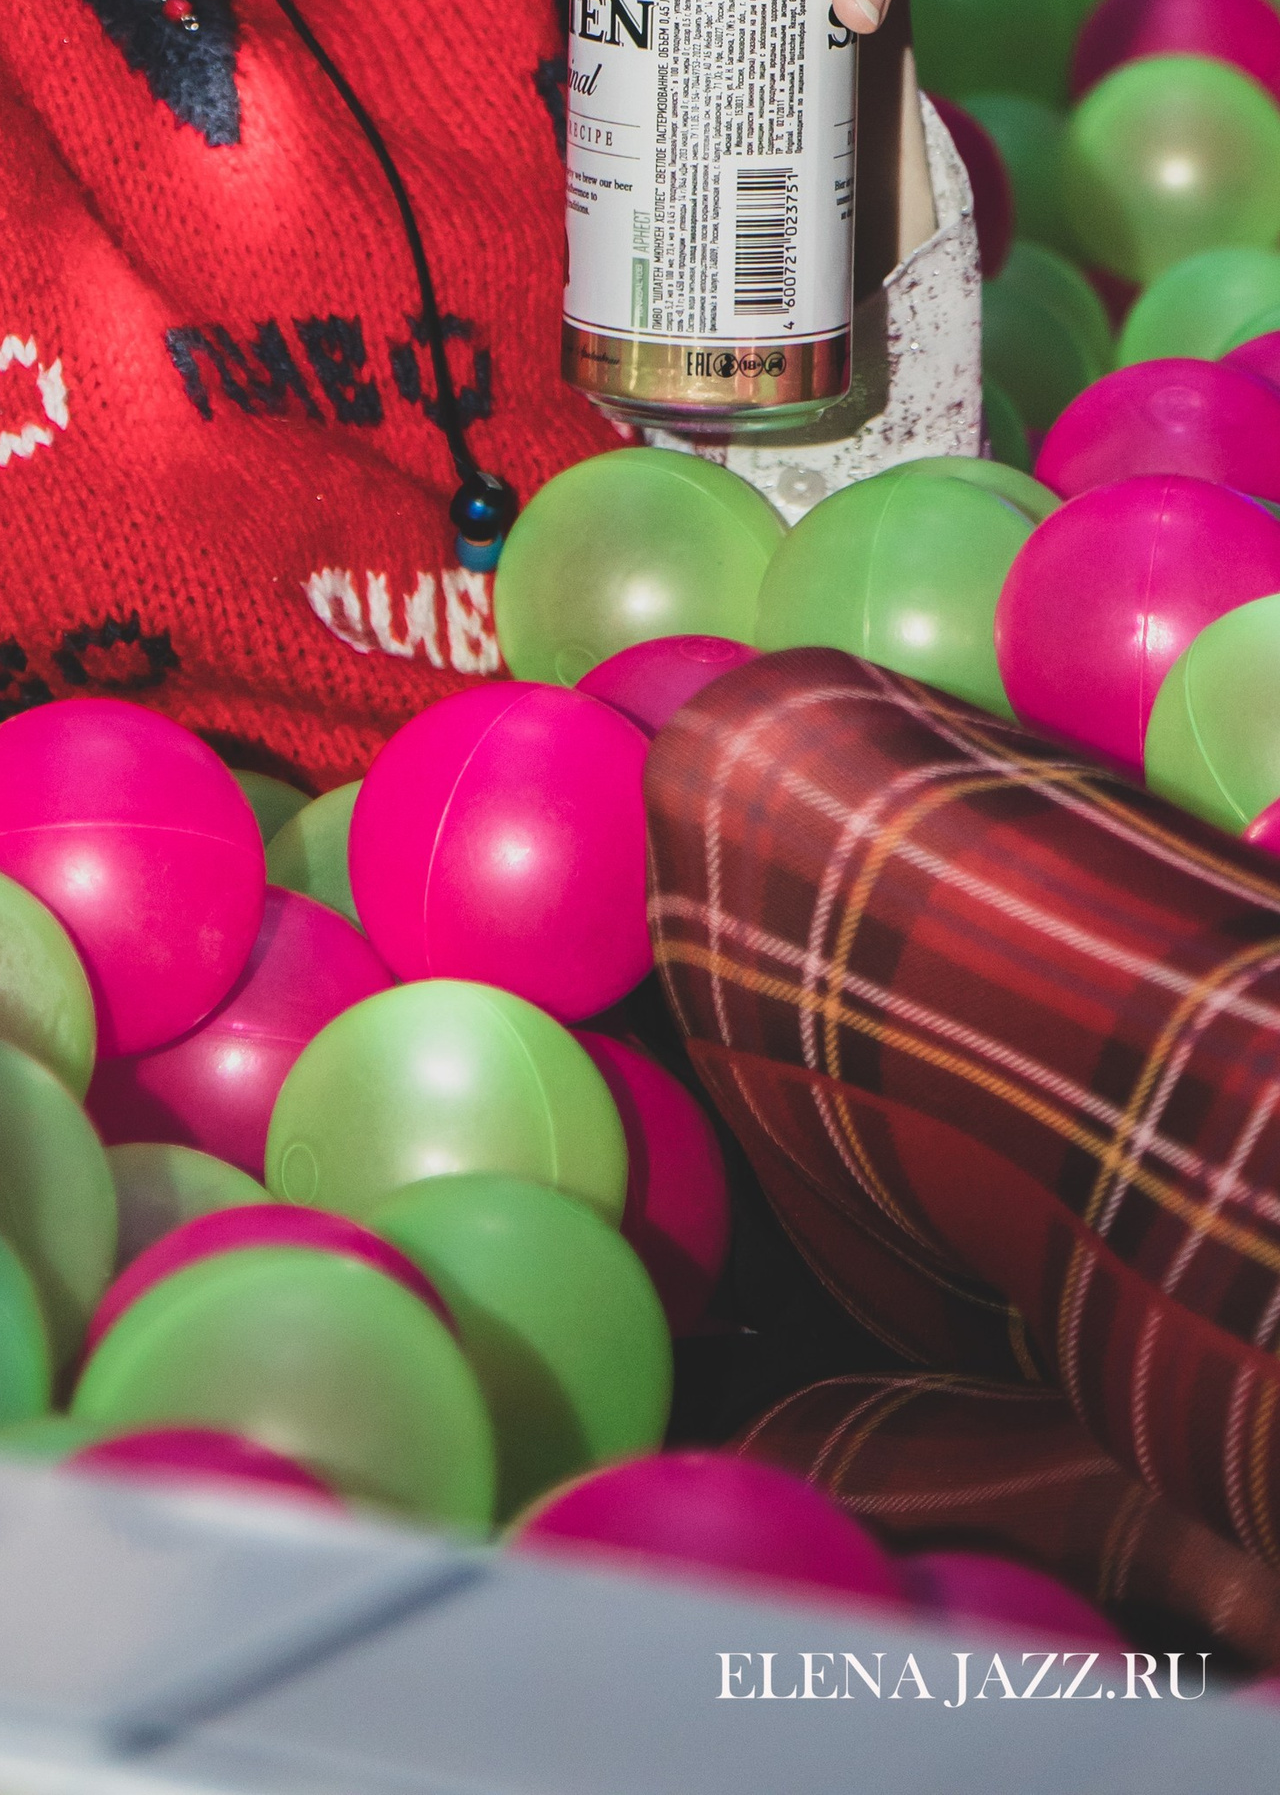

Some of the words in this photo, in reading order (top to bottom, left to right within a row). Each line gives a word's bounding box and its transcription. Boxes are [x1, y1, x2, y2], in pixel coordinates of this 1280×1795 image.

[658, 28, 669, 58] ОБЪЕМ
[655, 148, 667, 184] СВЕТЛОЕ
[599, 179, 612, 188] our
[614, 179, 633, 191] beer
[654, 187, 666, 223] ХЕЛЛЕС"
[785, 173, 798, 236] 023751
[653, 227, 665, 263] МЮНХЕН
[652, 267, 664, 303] "ШПАТЕН
[784, 246, 796, 307] 600721
[652, 308, 663, 330] ПИВО
[300, 566, 500, 676] ПИВ
